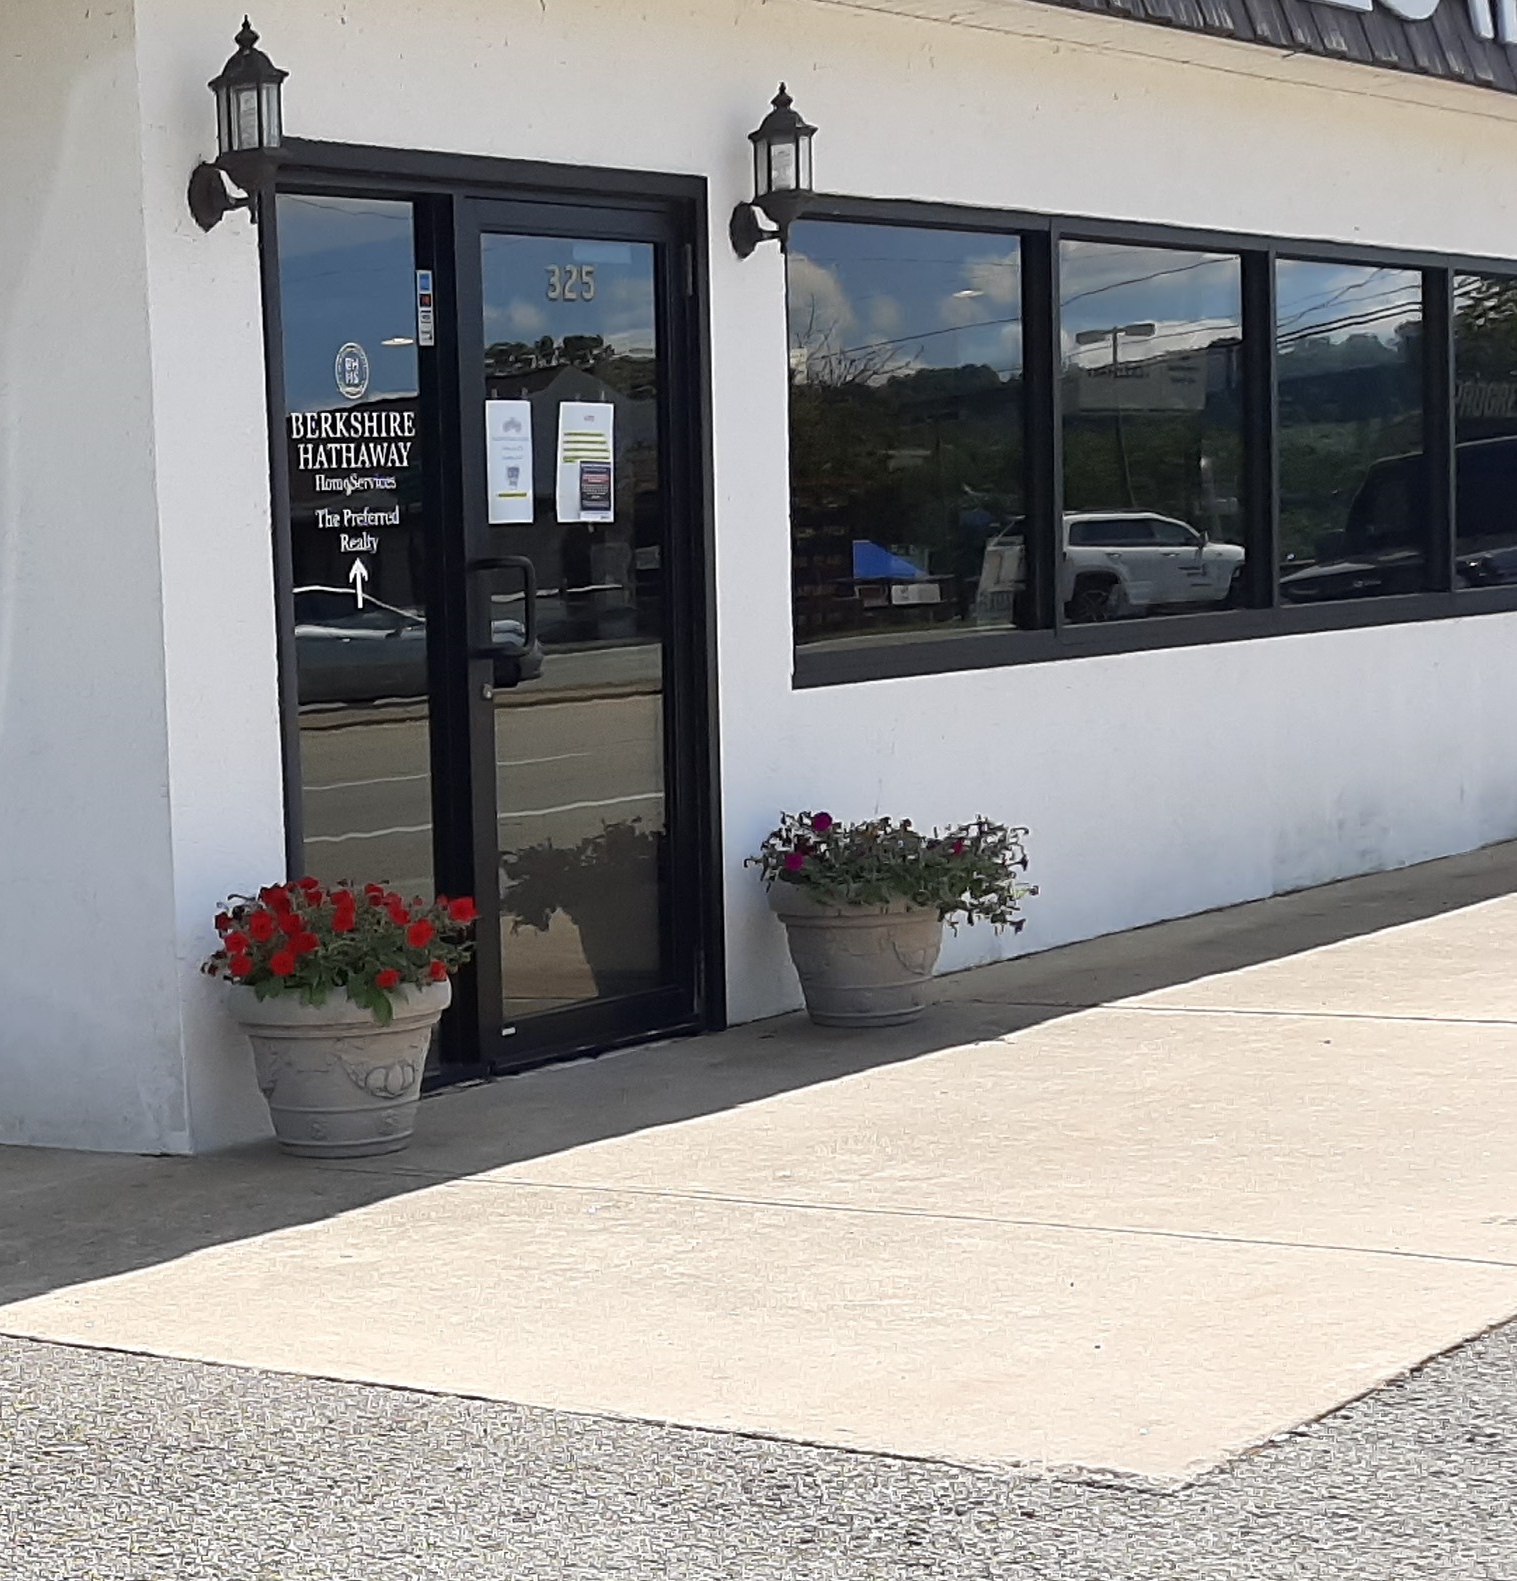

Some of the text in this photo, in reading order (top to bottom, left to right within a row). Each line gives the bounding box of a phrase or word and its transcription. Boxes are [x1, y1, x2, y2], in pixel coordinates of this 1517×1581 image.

[545, 264, 597, 301] 325
[291, 412, 415, 439] BERKSHIRE
[298, 442, 411, 469] HATHAWAY
[315, 505, 400, 528] The Preferred
[340, 532, 379, 553] Realty
